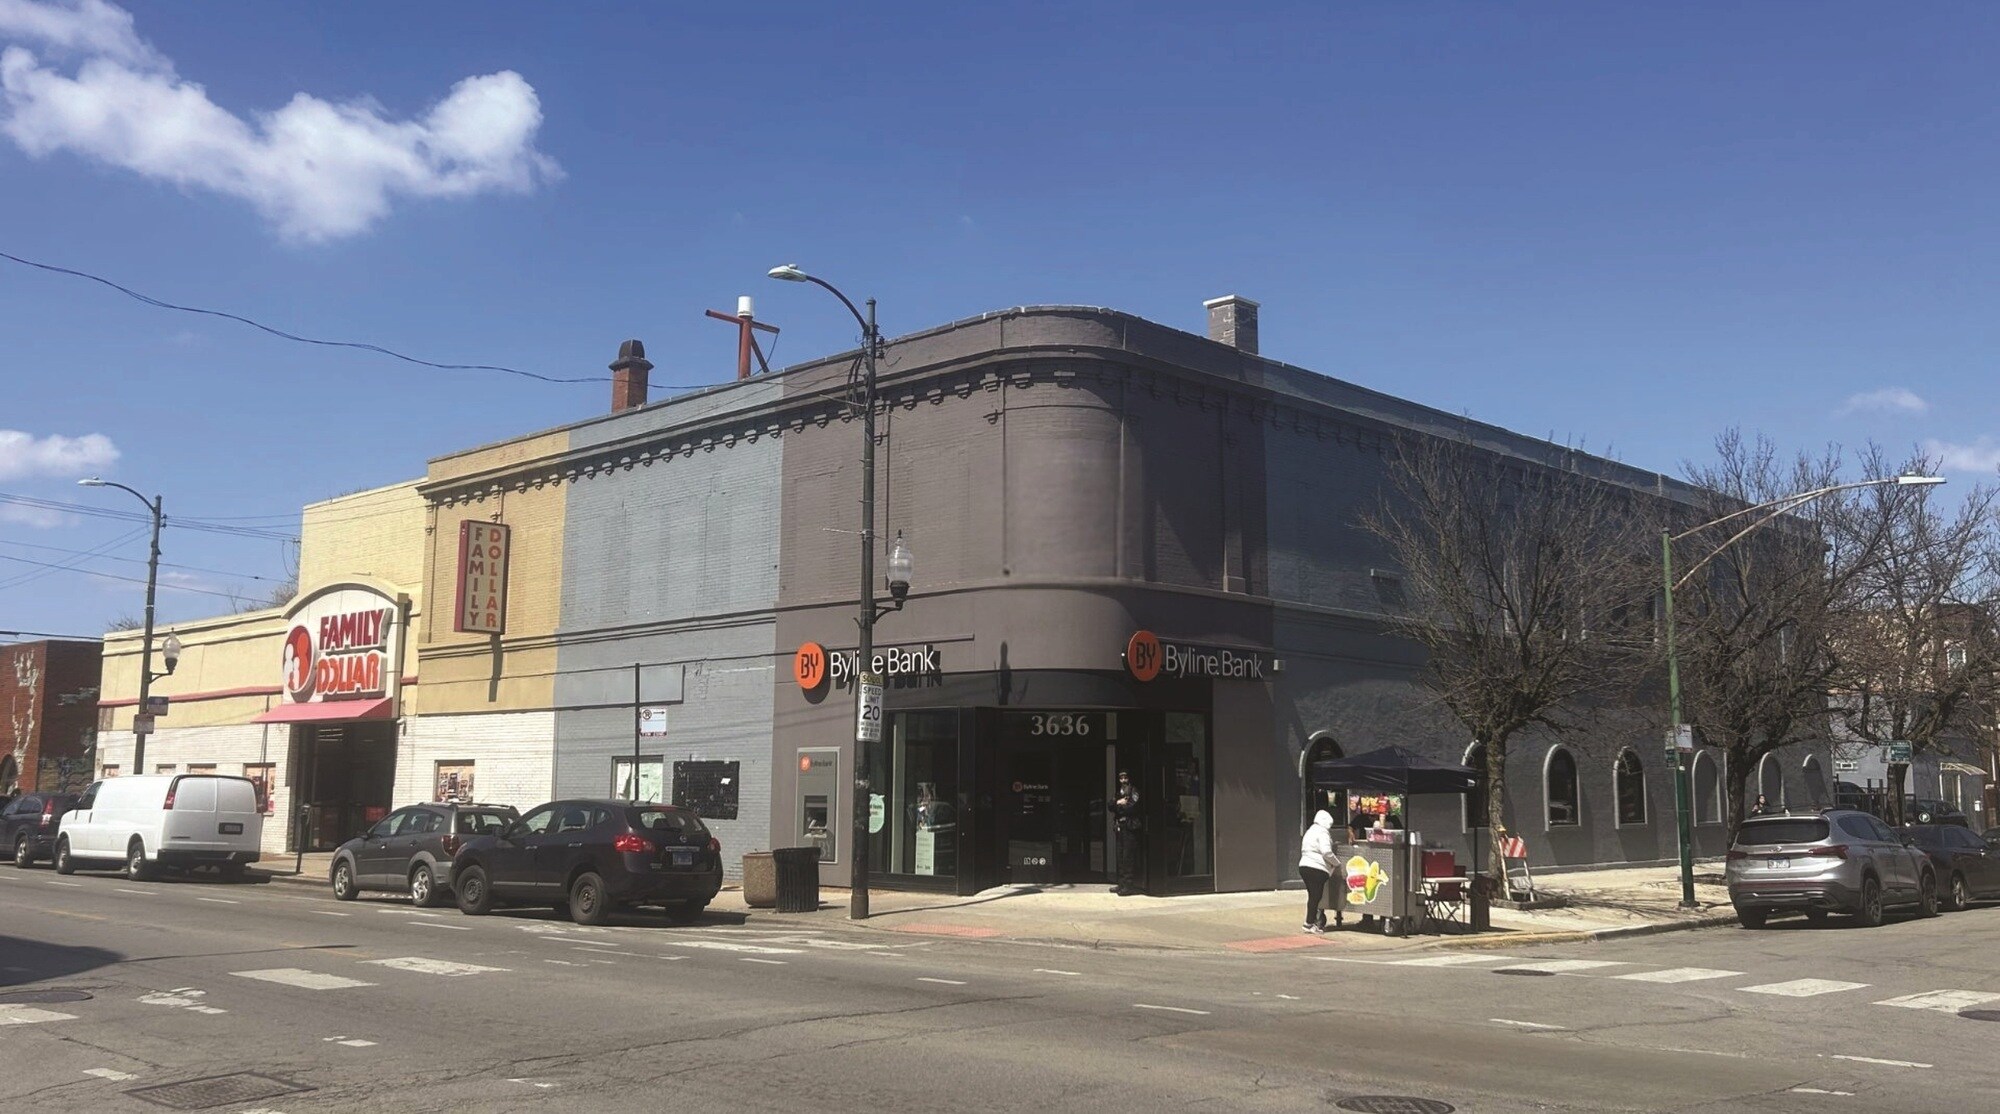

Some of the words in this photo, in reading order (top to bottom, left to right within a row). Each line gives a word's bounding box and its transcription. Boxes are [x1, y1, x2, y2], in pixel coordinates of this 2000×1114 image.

[469, 527, 485, 626] FAMILY
[485, 528, 502, 628] DOLLAR
[319, 608, 384, 651] FAMILY
[801, 653, 819, 679] BY
[830, 650, 884, 682] Bylie
[888, 644, 936, 674] Bank
[1136, 642, 1156, 670] BY
[1166, 645, 1219, 678] Byline
[1222, 650, 1263, 678] Bank
[316, 652, 380, 694] DOLLAR
[863, 686, 882, 696] SPEED
[865, 695, 880, 704] LIMIT
[863, 704, 880, 721] 20
[1031, 715, 1090, 736] 3636
